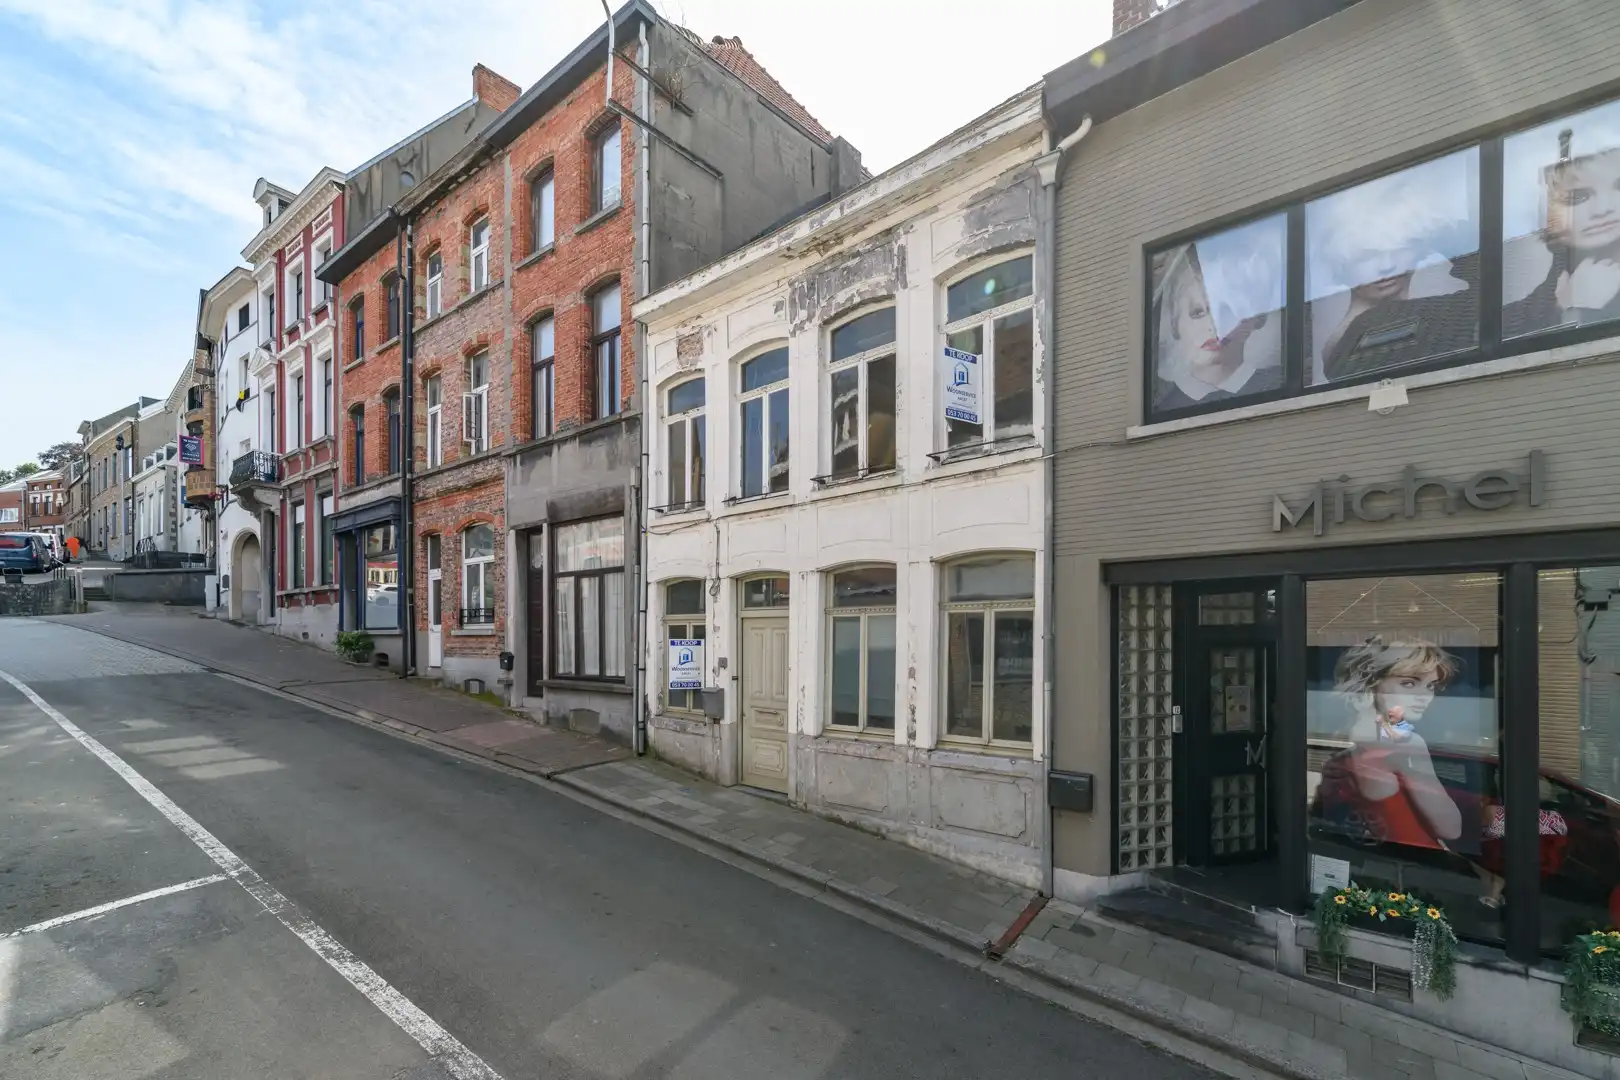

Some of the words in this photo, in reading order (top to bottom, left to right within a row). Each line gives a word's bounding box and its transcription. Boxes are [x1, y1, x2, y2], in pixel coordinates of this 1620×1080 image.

[949, 349, 956, 358] TE
[957, 352, 973, 362] KOOP
[947, 409, 957, 417] 053
[1273, 449, 1546, 537] Michel
